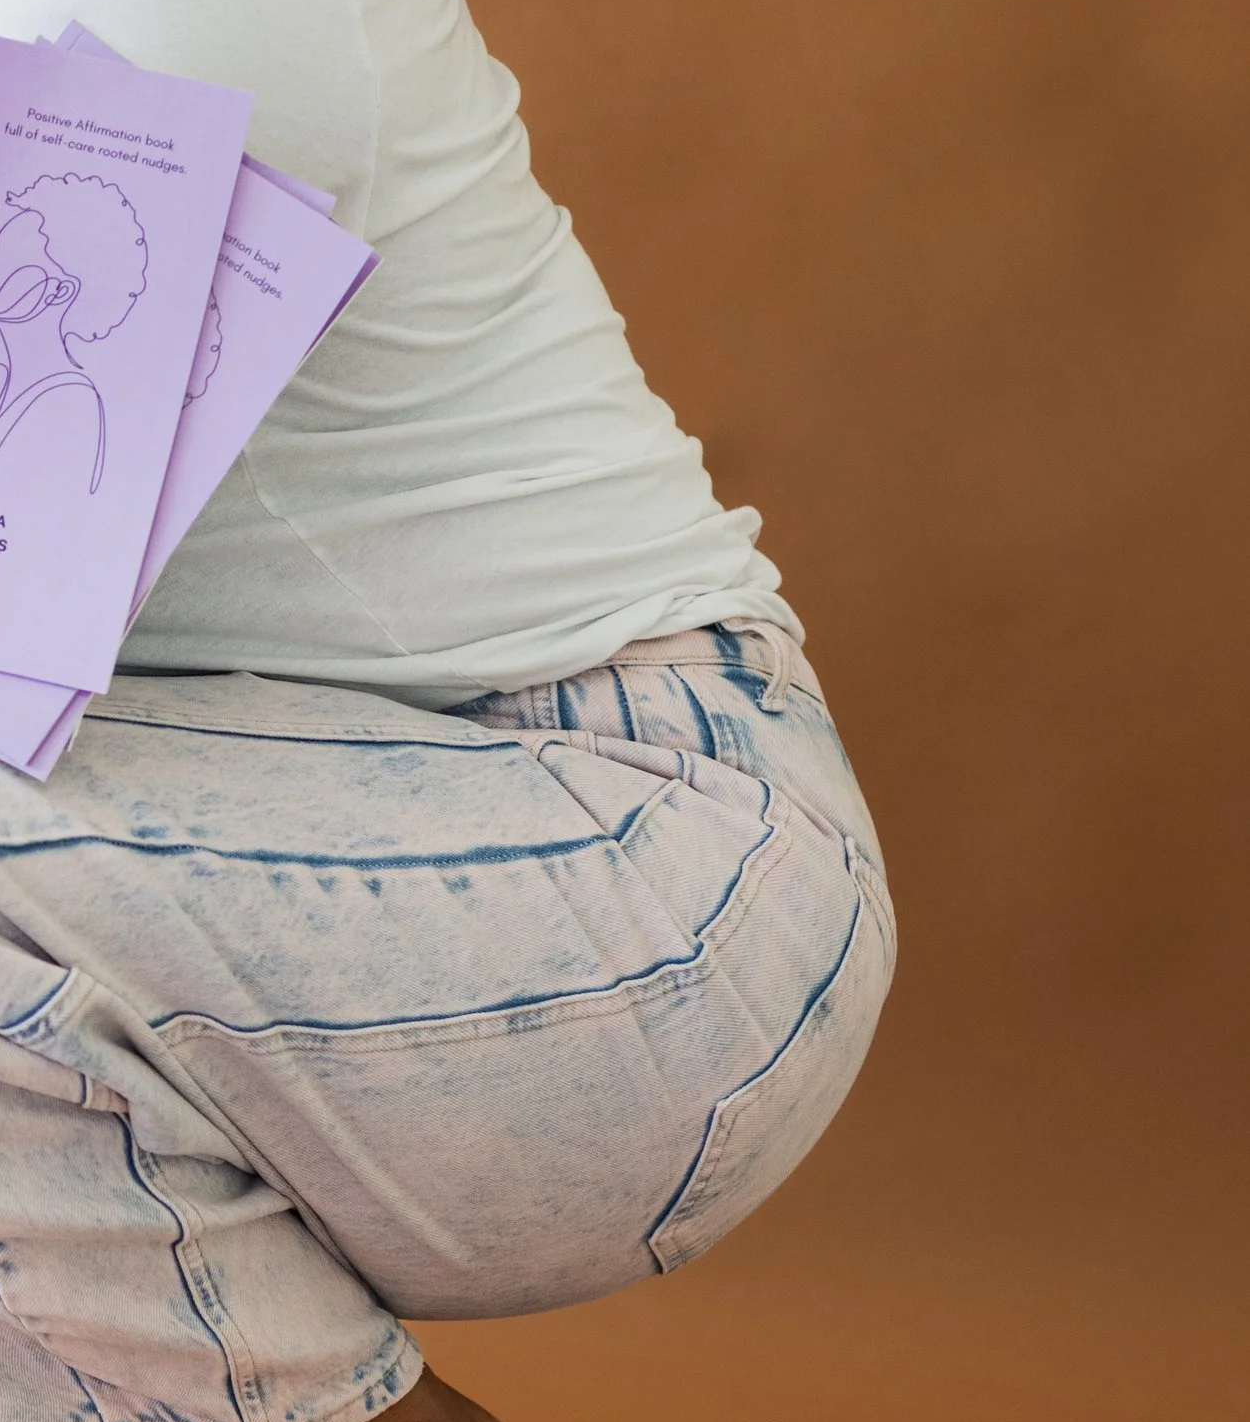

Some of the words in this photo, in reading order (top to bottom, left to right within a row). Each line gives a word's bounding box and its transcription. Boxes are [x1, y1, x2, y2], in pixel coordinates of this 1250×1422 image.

[3, 121, 24, 136] full
[25, 127, 41, 141] of
[41, 133, 96, 155] self-care
[98, 144, 140, 165] rooted
[141, 153, 188, 175] nudges.
[26, 107, 73, 129] Positive
[75, 118, 143, 144] Affirmation
[145, 133, 175, 152] book
[253, 249, 281, 273] book
